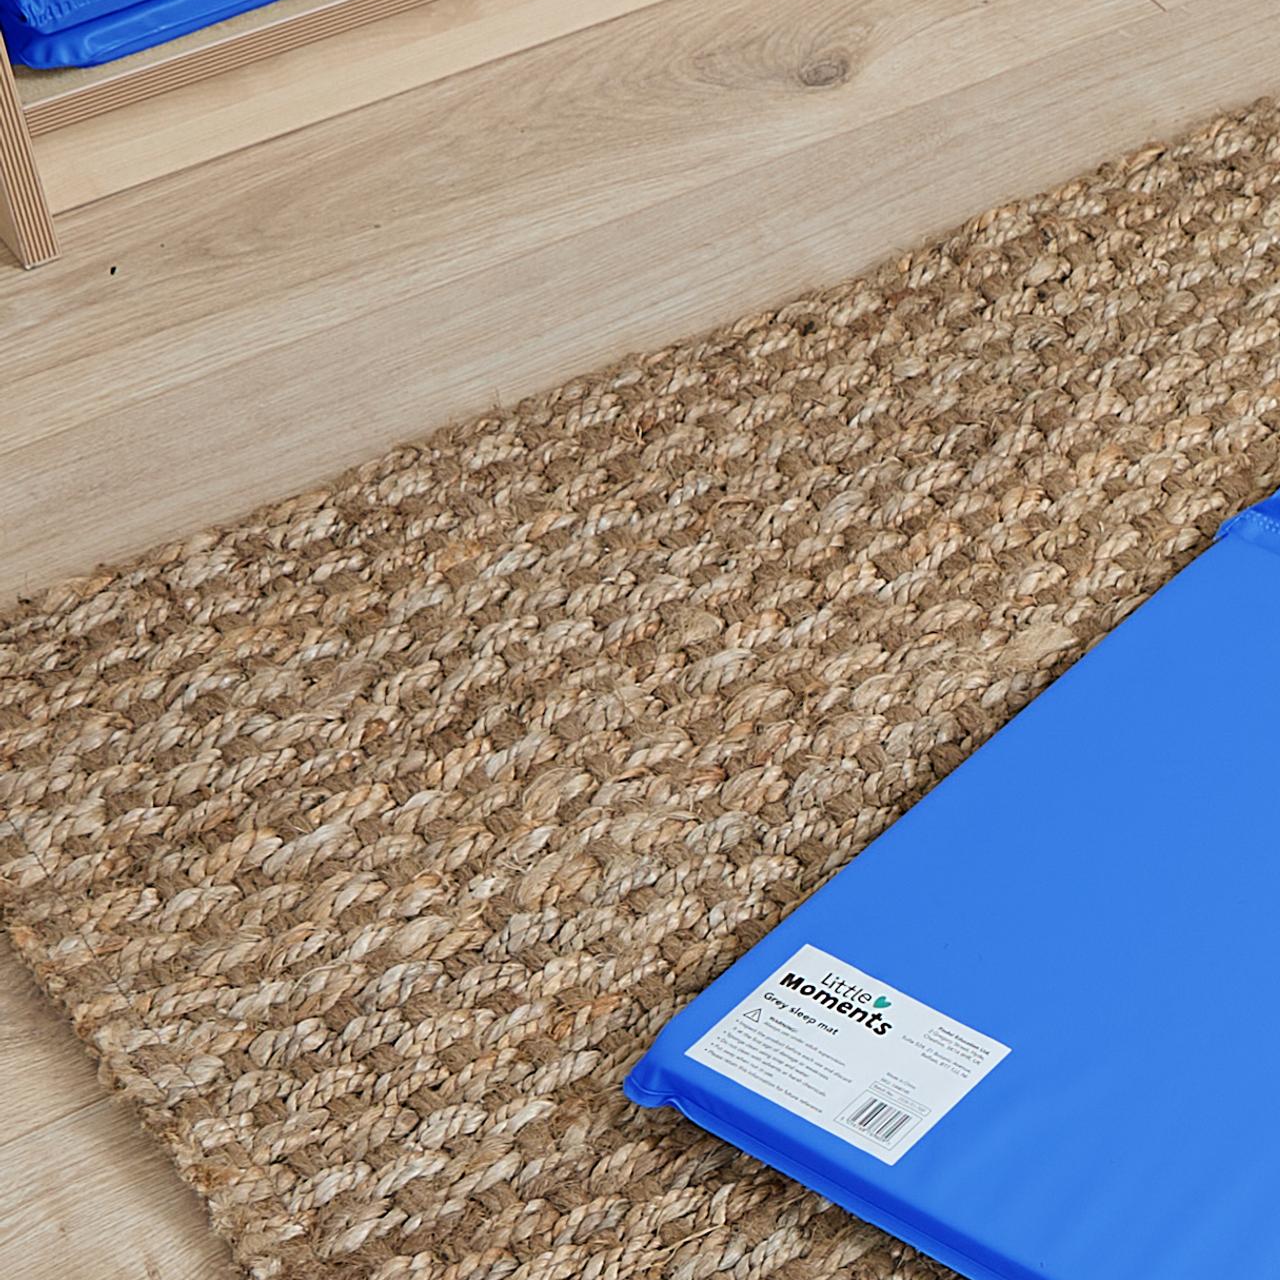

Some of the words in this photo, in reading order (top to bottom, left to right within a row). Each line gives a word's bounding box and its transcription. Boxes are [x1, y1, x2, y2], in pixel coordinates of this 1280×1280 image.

[779, 972, 893, 1036] Moments
[821, 971, 872, 1004] Little
[764, 992, 789, 1010] Grey
[789, 1008, 817, 1024] sleep
[817, 1023, 839, 1036] mat
